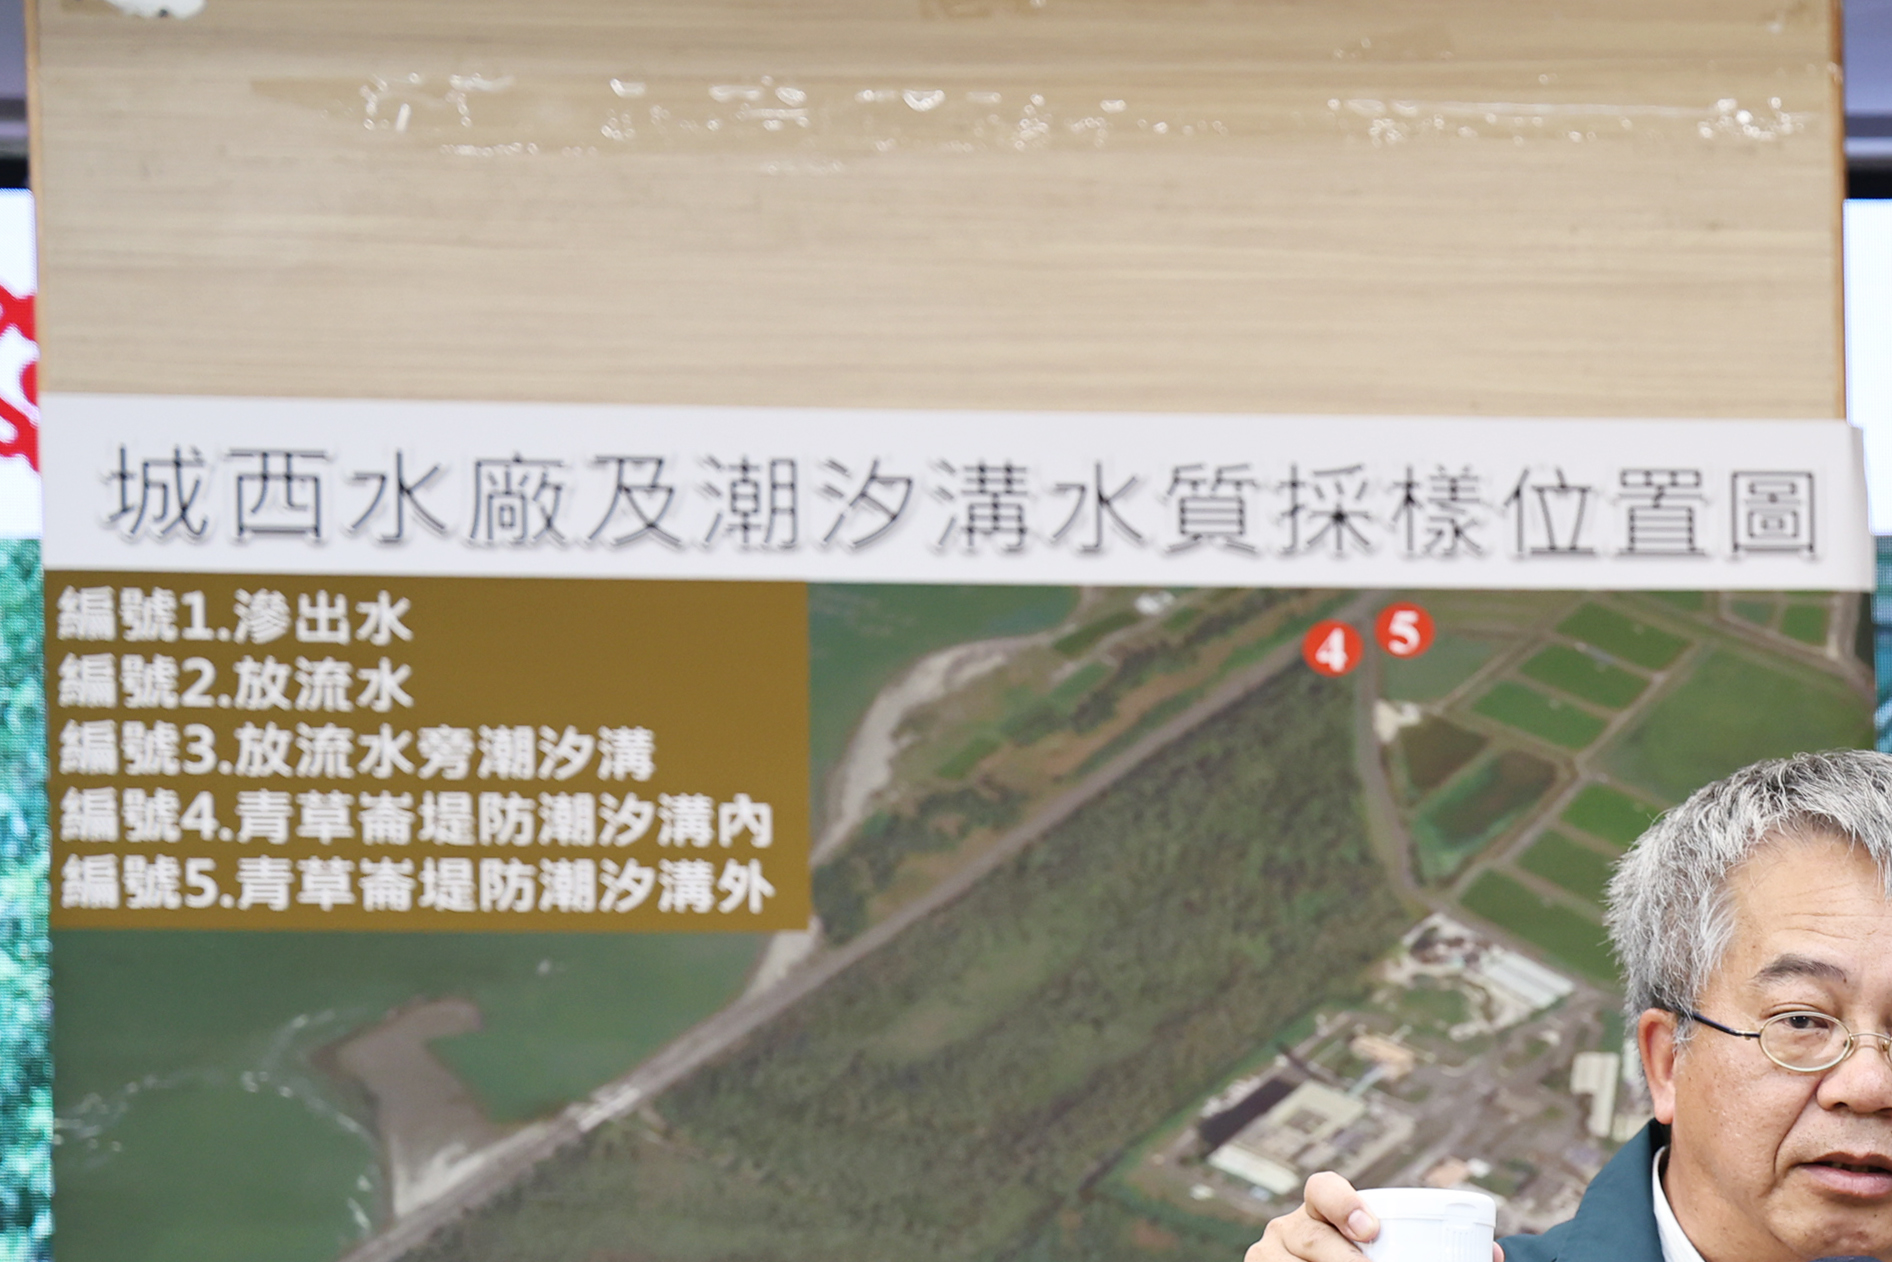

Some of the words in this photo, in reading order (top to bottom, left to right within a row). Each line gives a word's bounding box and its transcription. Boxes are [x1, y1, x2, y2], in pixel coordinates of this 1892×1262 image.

[106, 443, 1817, 557] 城西水廠及潮汐溝水質採樣位置圖
[57, 585, 414, 645] 編號1.滲出水
[1388, 610, 1421, 656] 5
[1315, 627, 1349, 673] 4
[58, 652, 414, 713] 編號2.放流水
[59, 719, 656, 781] 編號3.放流水旁潮汐溝
[61, 853, 776, 914] 編號5.青草崙堤防潮汐溝外
